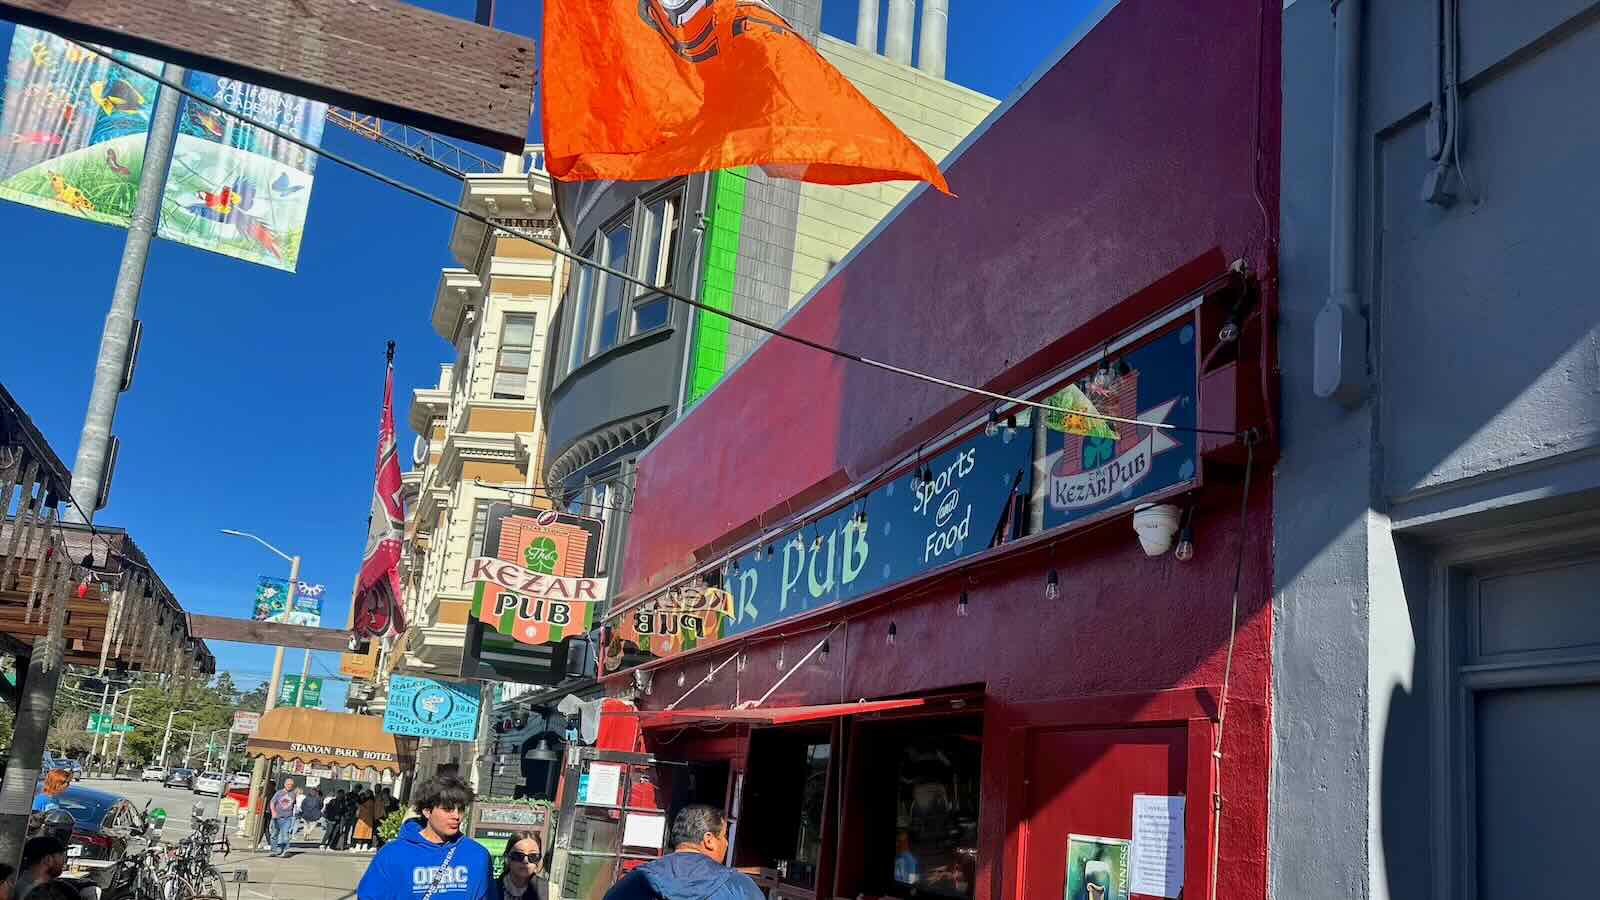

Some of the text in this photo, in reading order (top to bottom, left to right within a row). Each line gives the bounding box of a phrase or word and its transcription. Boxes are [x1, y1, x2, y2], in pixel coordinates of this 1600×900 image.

[527, 546, 552, 561] The
[779, 519, 870, 612] PUB
[470, 558, 599, 600] KEZAR
[494, 592, 571, 626] PUB
[290, 743, 393, 761] STANYAN PARK HOTEL
